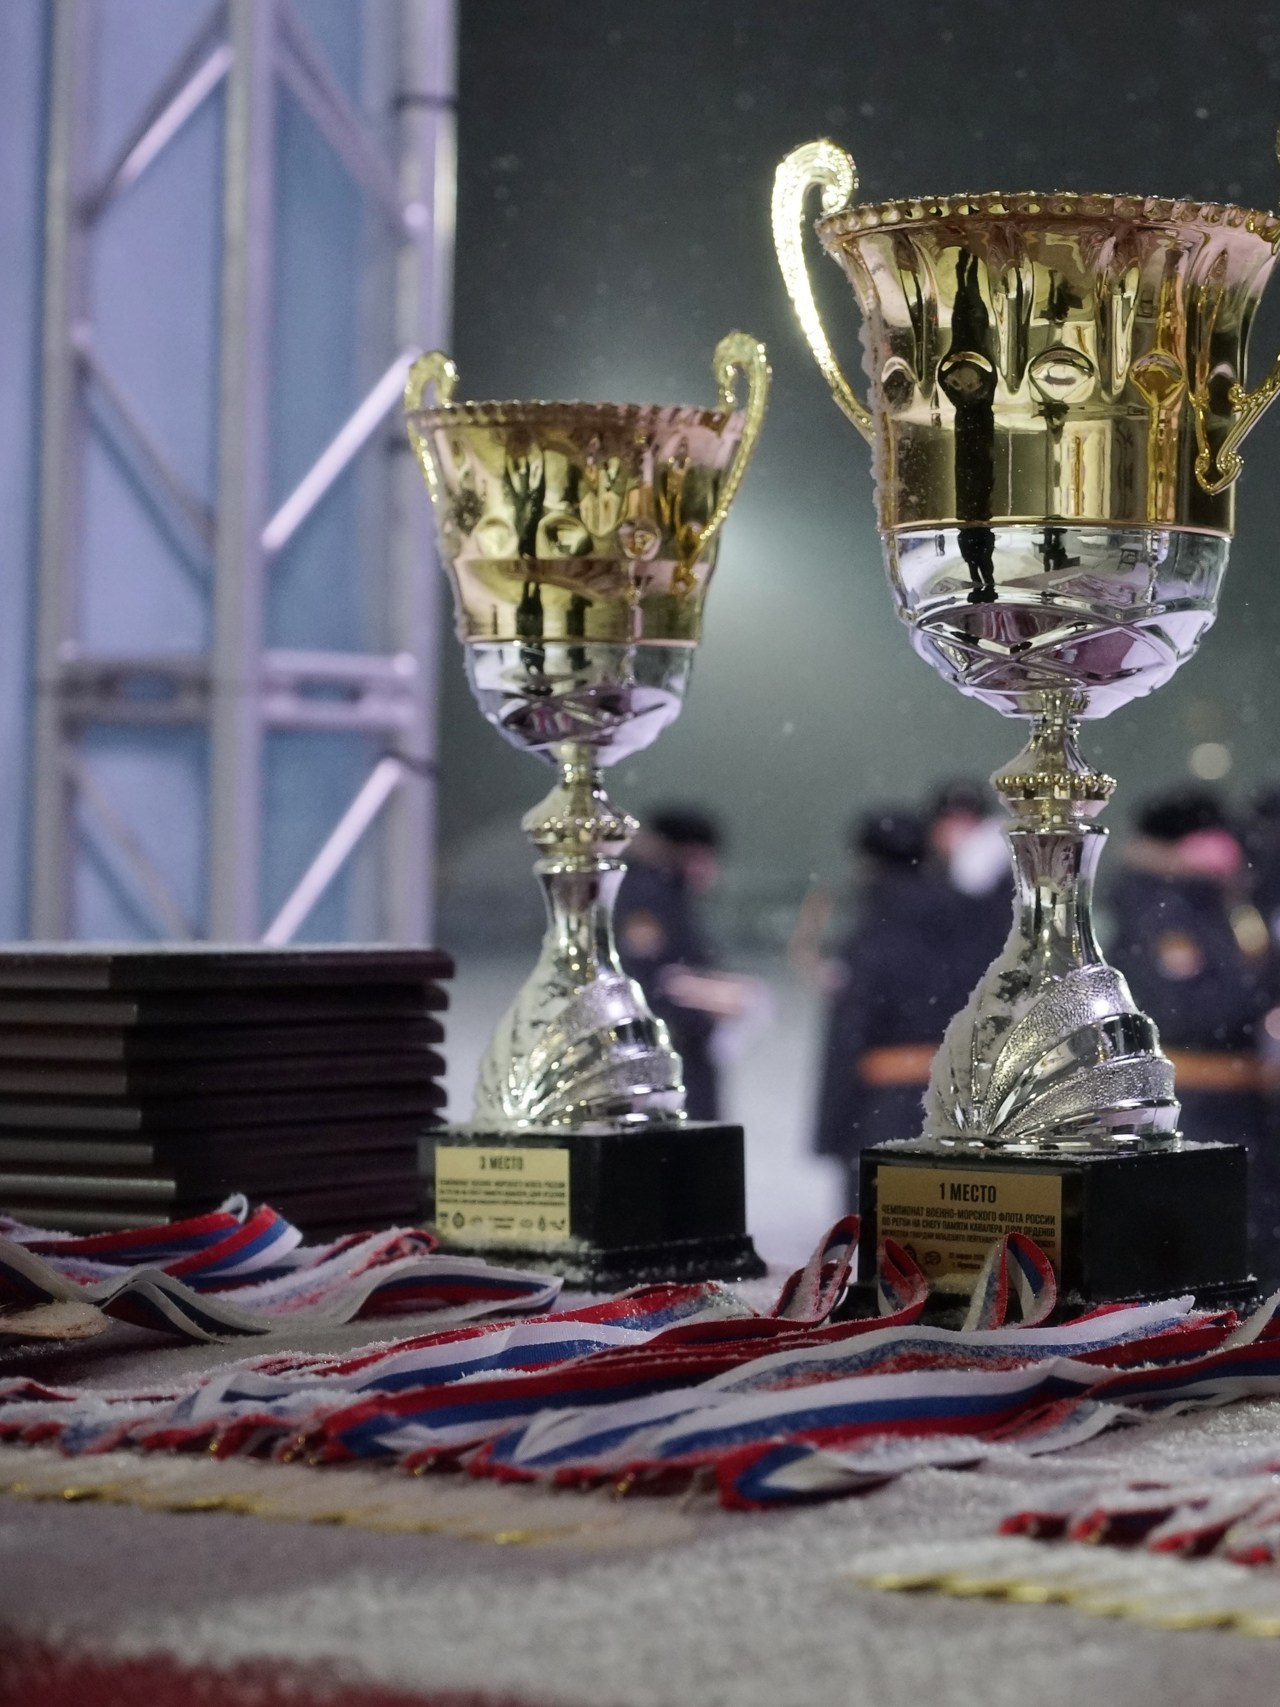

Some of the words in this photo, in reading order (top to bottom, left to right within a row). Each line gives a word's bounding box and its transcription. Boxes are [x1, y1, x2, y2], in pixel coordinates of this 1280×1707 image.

[939, 1182, 945, 1200] 1
[950, 1183, 997, 1203] МЕСТО
[998, 1211, 1024, 1223] ФЛОТА
[1025, 1213, 1055, 1225] РОССИИ
